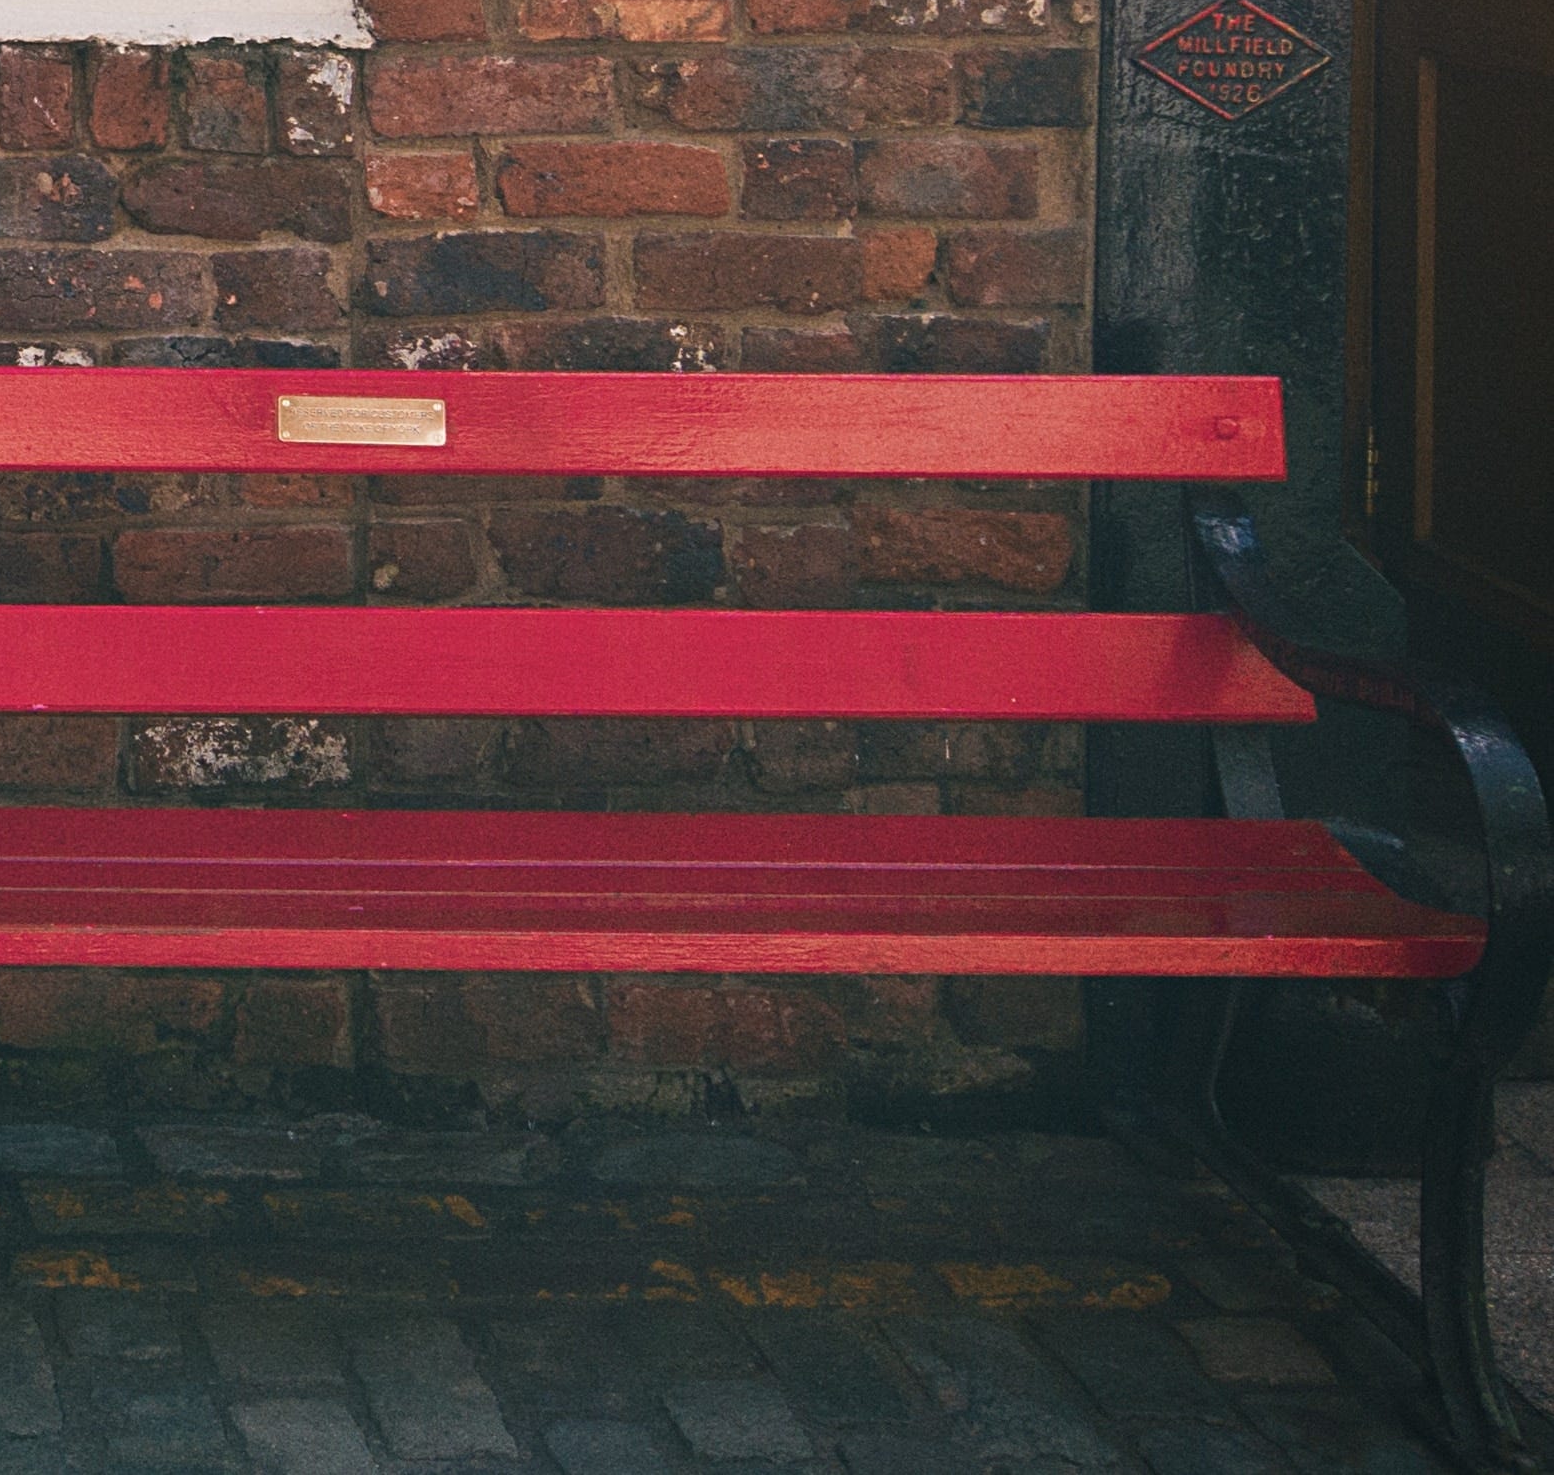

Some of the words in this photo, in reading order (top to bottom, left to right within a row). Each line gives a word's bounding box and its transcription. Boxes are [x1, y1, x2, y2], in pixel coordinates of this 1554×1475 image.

[1211, 12, 1256, 32] THE
[1177, 35, 1294, 56] MILLFIELD
[1177, 59, 1286, 80] FOUNDRY
